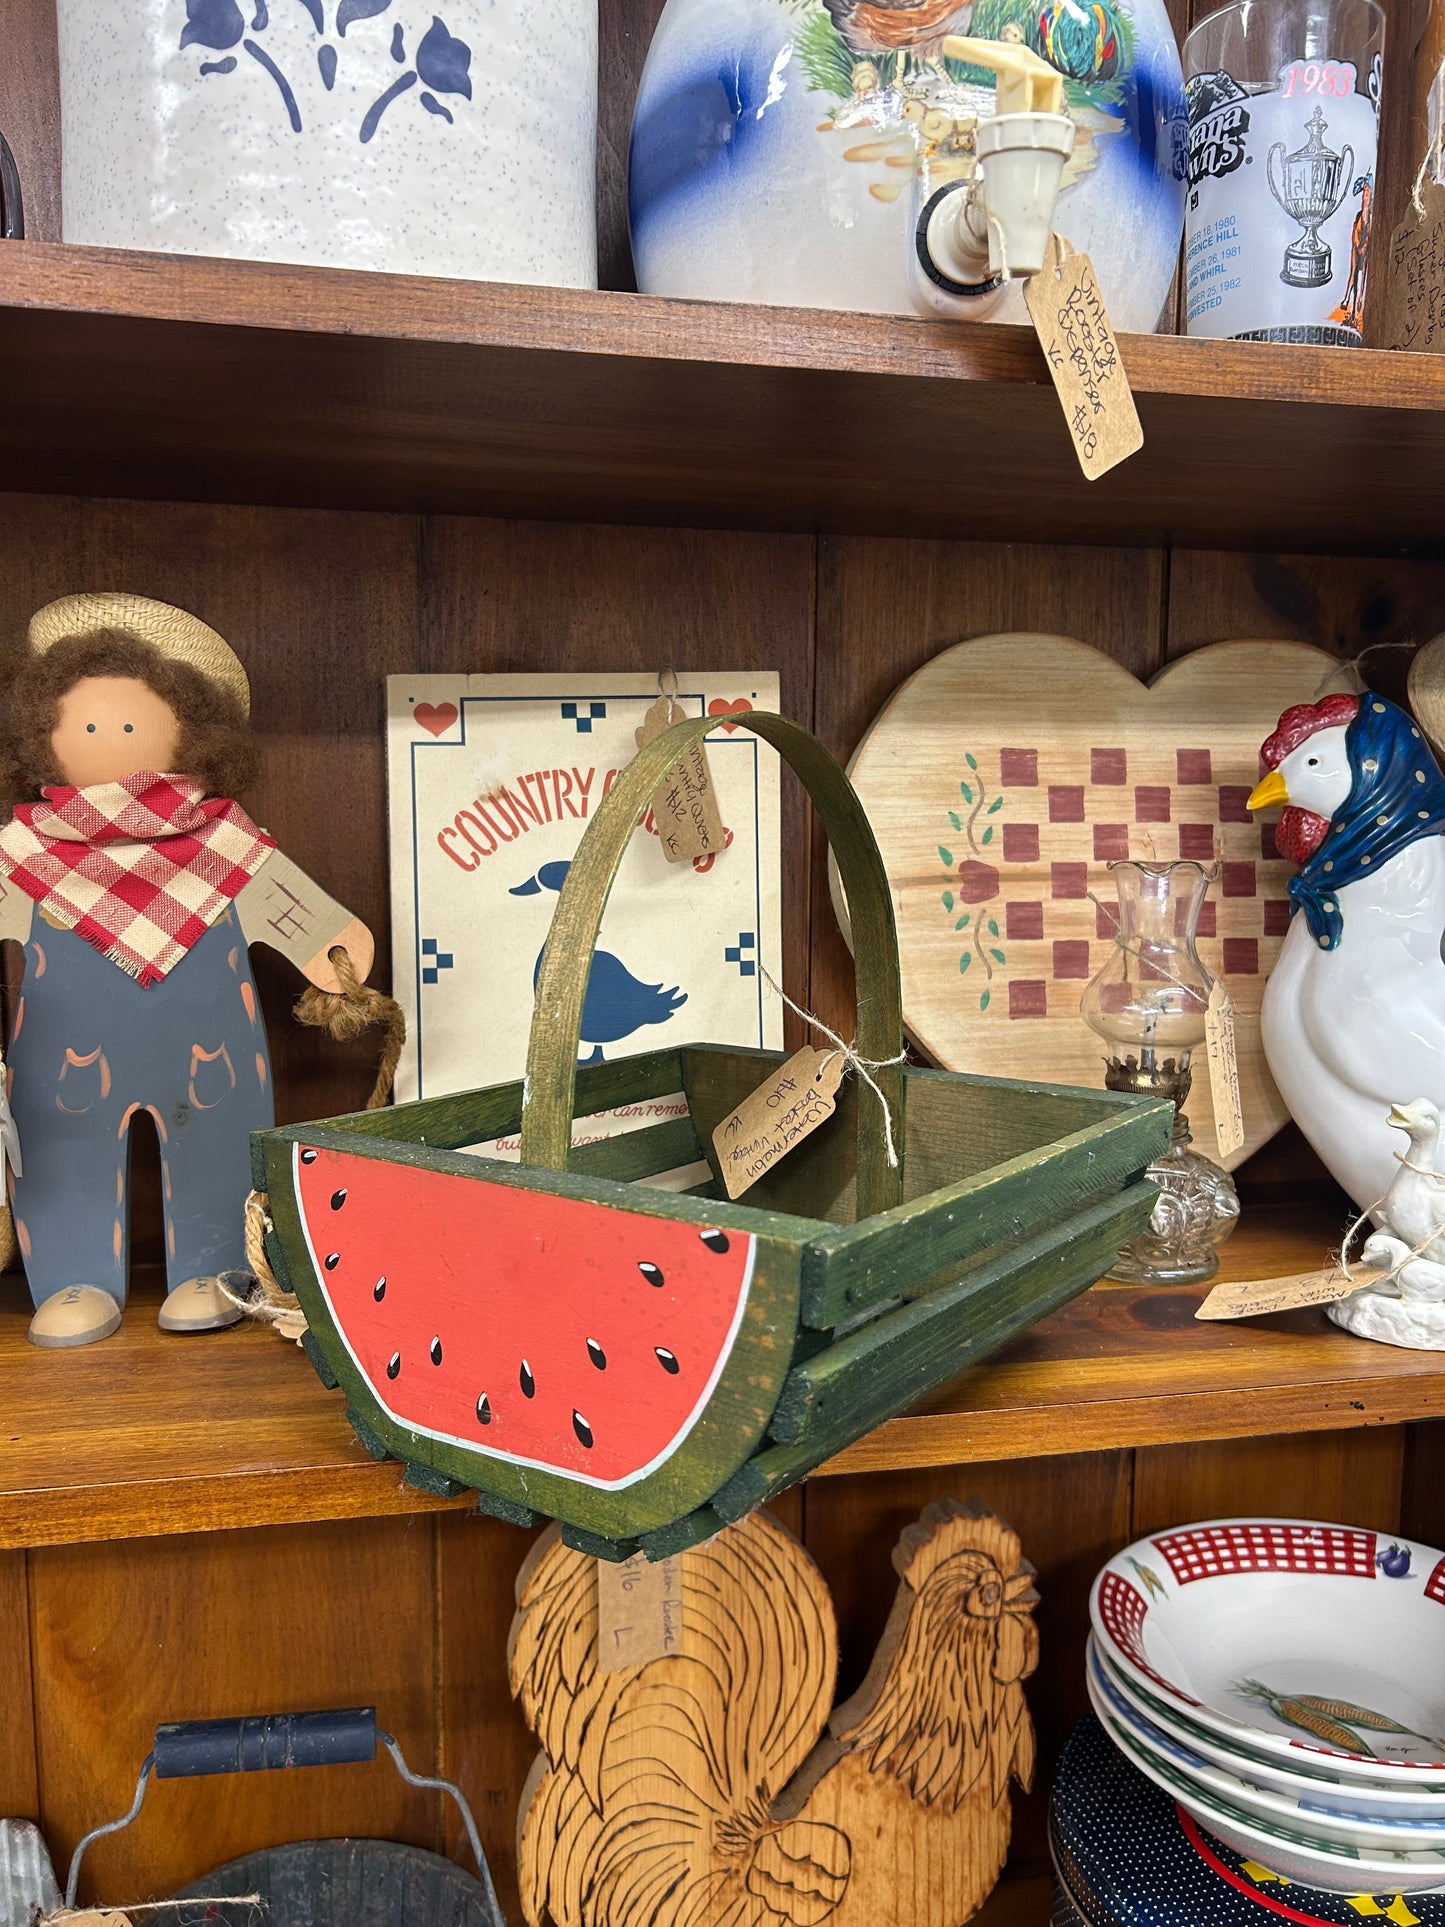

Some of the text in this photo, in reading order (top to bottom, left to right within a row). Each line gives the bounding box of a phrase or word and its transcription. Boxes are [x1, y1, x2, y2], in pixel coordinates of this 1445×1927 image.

[1282, 64, 1353, 98] 1983
[1215, 215, 1236, 231] 1980
[1216, 227, 1239, 243] HILL
[1222, 246, 1241, 259] 1981
[1394, 229, 1415, 276] $12
[1429, 222, 1443, 280] Super
[1199, 263, 1227, 281] WHIRL
[1220, 277, 1242, 292] 1982
[1080, 267, 1116, 375] Vintage
[1425, 286, 1440, 345] Derby
[1066, 285, 1110, 383] Rooster
[1072, 405, 1098, 459] $18
[689, 744, 708, 796] intage
[437, 767, 596, 872] COUNTRY
[666, 785, 687, 822] $12
[766, 1078, 797, 1108] $10
[613, 1105, 644, 1117] can
[614, 1557, 646, 1591] $16
[662, 1559, 678, 1593] oden
